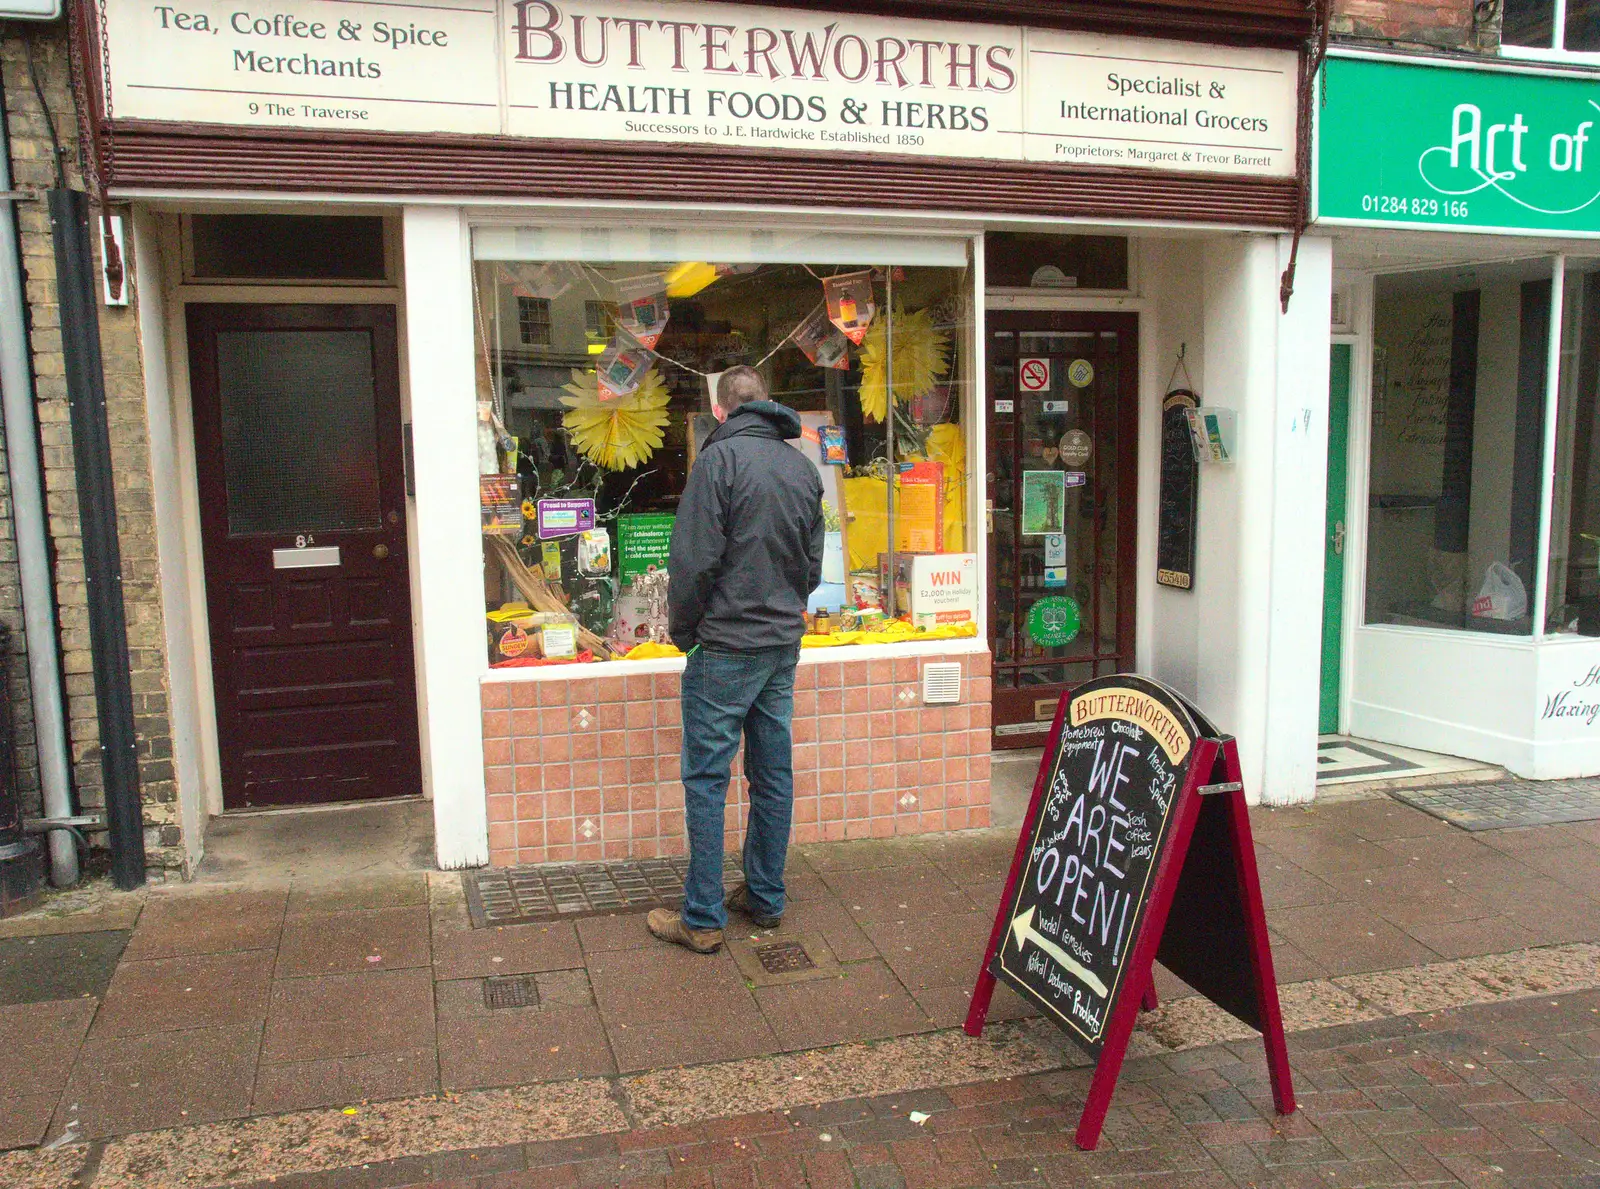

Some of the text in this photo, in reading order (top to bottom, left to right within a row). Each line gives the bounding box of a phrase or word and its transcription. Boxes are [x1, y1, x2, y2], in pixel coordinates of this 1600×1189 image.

[154, 6, 449, 50] Tea, Coffee & Spice
[510, 0, 1018, 93] BUTTERWORTHS
[233, 49, 382, 79] Merchants
[1107, 72, 1226, 99] Specialist &
[248, 102, 370, 120] 9 The Traverse
[548, 81, 990, 132] HEALTH FOODS & HERBS
[1060, 100, 1269, 132] International Grocers
[624, 120, 699, 135] Successors
[704, 125, 718, 135] to
[750, 126, 815, 141] Hardwicke
[820, 129, 891, 145] Established
[896, 134, 925, 146] 1850
[1450, 103, 1593, 180] Art of
[1055, 143, 1272, 167] Proprietors: Margaret & Trevor Barrett
[1362, 194, 1469, 217] 01284 829 166
[920, 589, 945, 599] £2,000
[952, 588, 972, 597] Holiday
[930, 570, 961, 587] WIN
[1062, 723, 1106, 742] Homebrew
[1077, 694, 1184, 756] BUTTERWORTHS
[1088, 738, 1140, 812] WE
[1147, 745, 1166, 781] herbs
[1063, 793, 1131, 880] ARE
[1037, 847, 1131, 966] OPEN!
